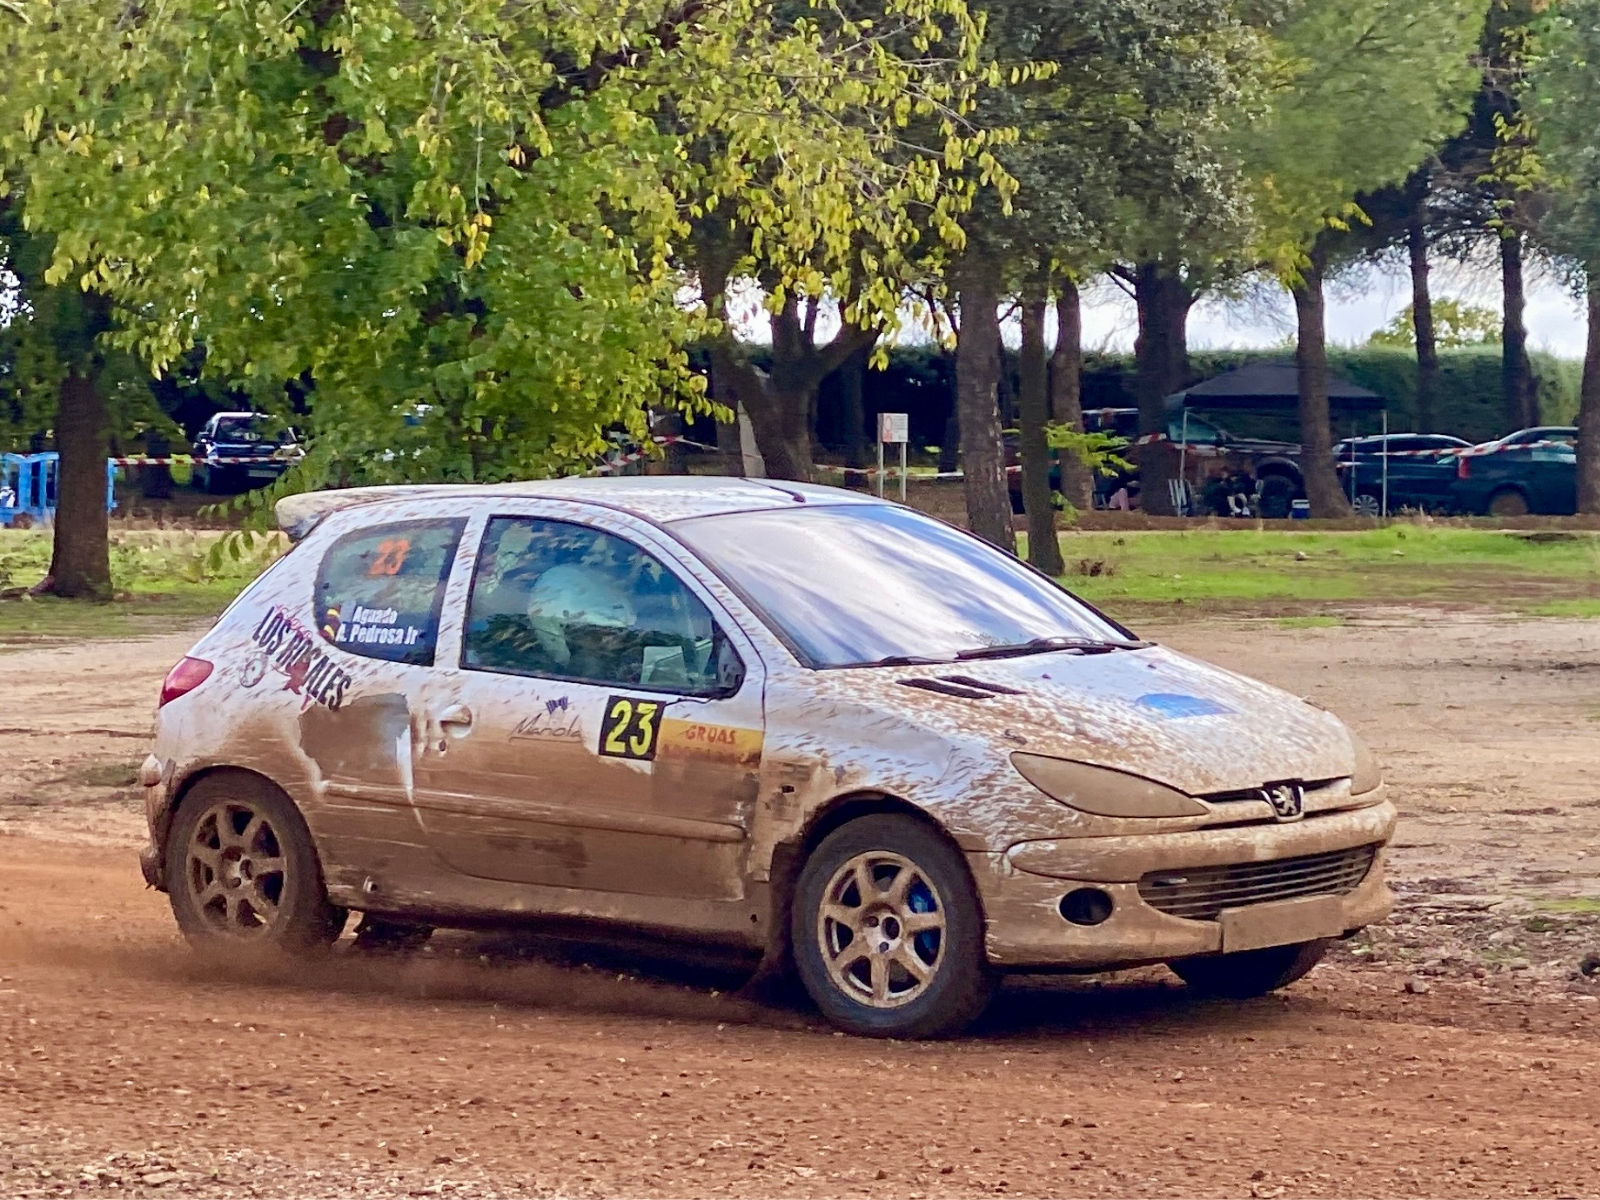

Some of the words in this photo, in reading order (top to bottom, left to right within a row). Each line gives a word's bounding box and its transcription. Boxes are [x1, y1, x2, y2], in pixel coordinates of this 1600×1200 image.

[367, 539, 410, 575] 23
[252, 606, 292, 655] LOS
[348, 624, 404, 644] Pedrosa
[605, 700, 658, 756] 23
[686, 724, 736, 744] GRUAS
